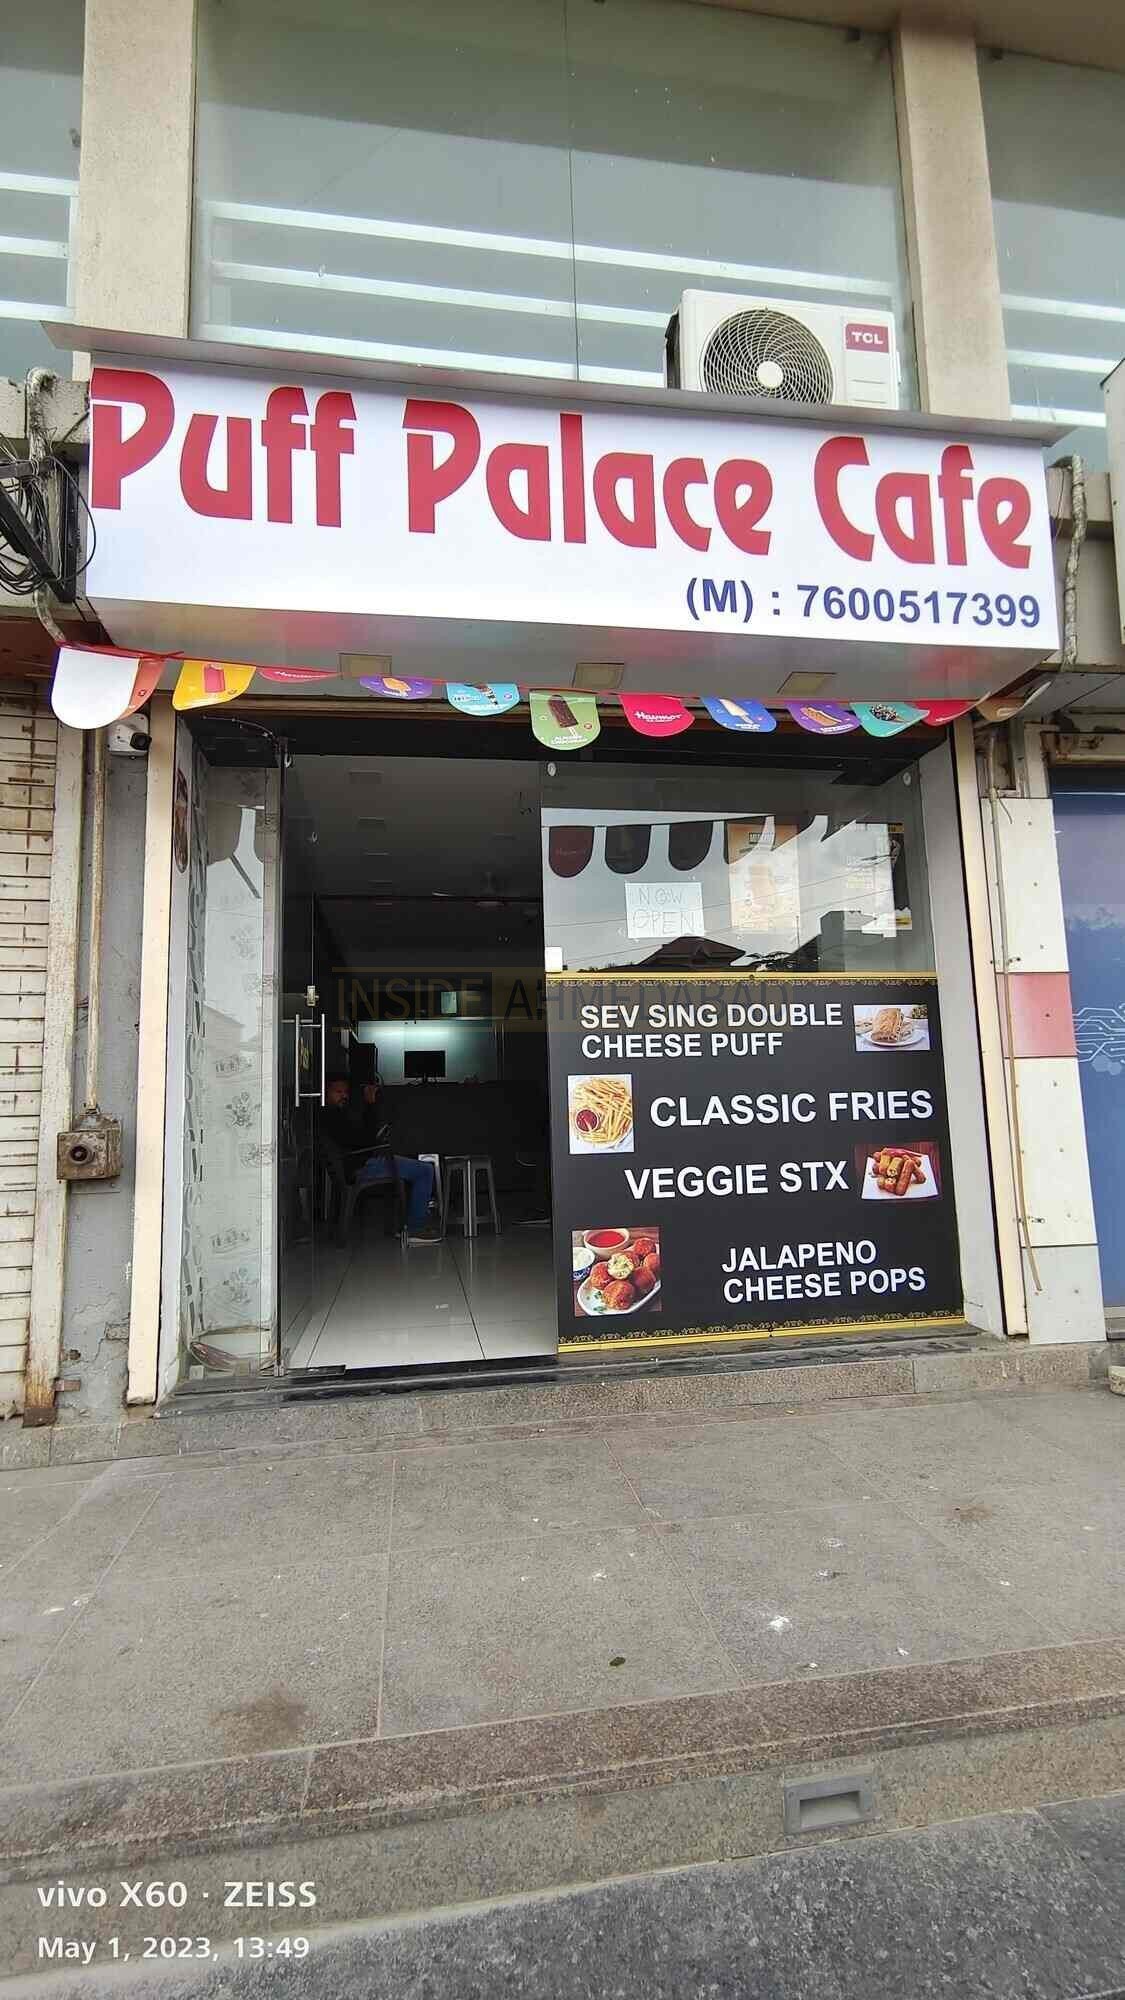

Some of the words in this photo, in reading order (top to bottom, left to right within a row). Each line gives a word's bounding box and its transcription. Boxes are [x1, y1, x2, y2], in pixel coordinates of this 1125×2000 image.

[851, 331, 884, 345] TCL
[90, 367, 357, 528] Puff
[402, 398, 774, 556] Palace
[814, 436, 1033, 569] Cafe
[686, 578, 754, 623] (M)
[798, 584, 1040, 628] 7600517399
[639, 887, 684, 905] NOW
[632, 909, 696, 935] OPEN
[581, 1005, 640, 1029] SEV
[648, 1004, 717, 1027] SING
[727, 1003, 842, 1026] DOUBLE
[582, 1034, 703, 1058] CHEESE
[711, 1032, 783, 1056] PUFF
[649, 1092, 816, 1127] CLASSIC
[828, 1090, 933, 1120] FRIES
[624, 1164, 768, 1200] VEGGIE
[780, 1161, 849, 1192] STX
[721, 1240, 877, 1272] JALAPENO
[723, 1273, 842, 1304] CHEESE
[851, 1267, 926, 1295] POPS
